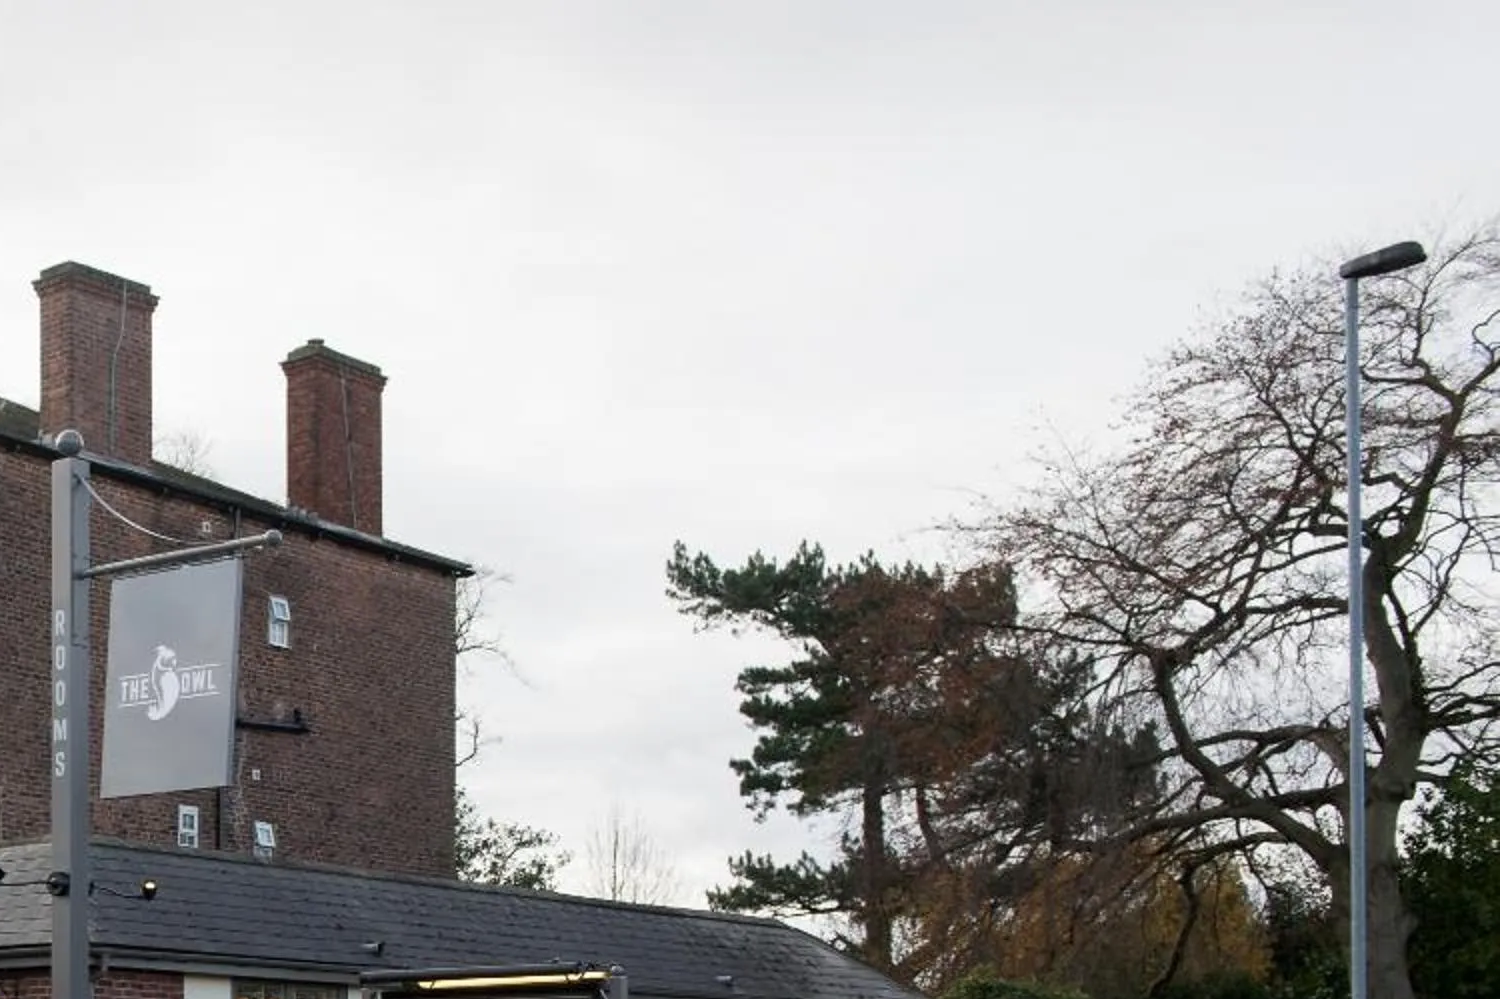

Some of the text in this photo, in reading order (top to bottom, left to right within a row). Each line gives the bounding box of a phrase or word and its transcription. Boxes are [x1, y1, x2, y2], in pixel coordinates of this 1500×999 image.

[54, 609, 67, 777] ROOMS
[121, 669, 217, 702] THE OWL
